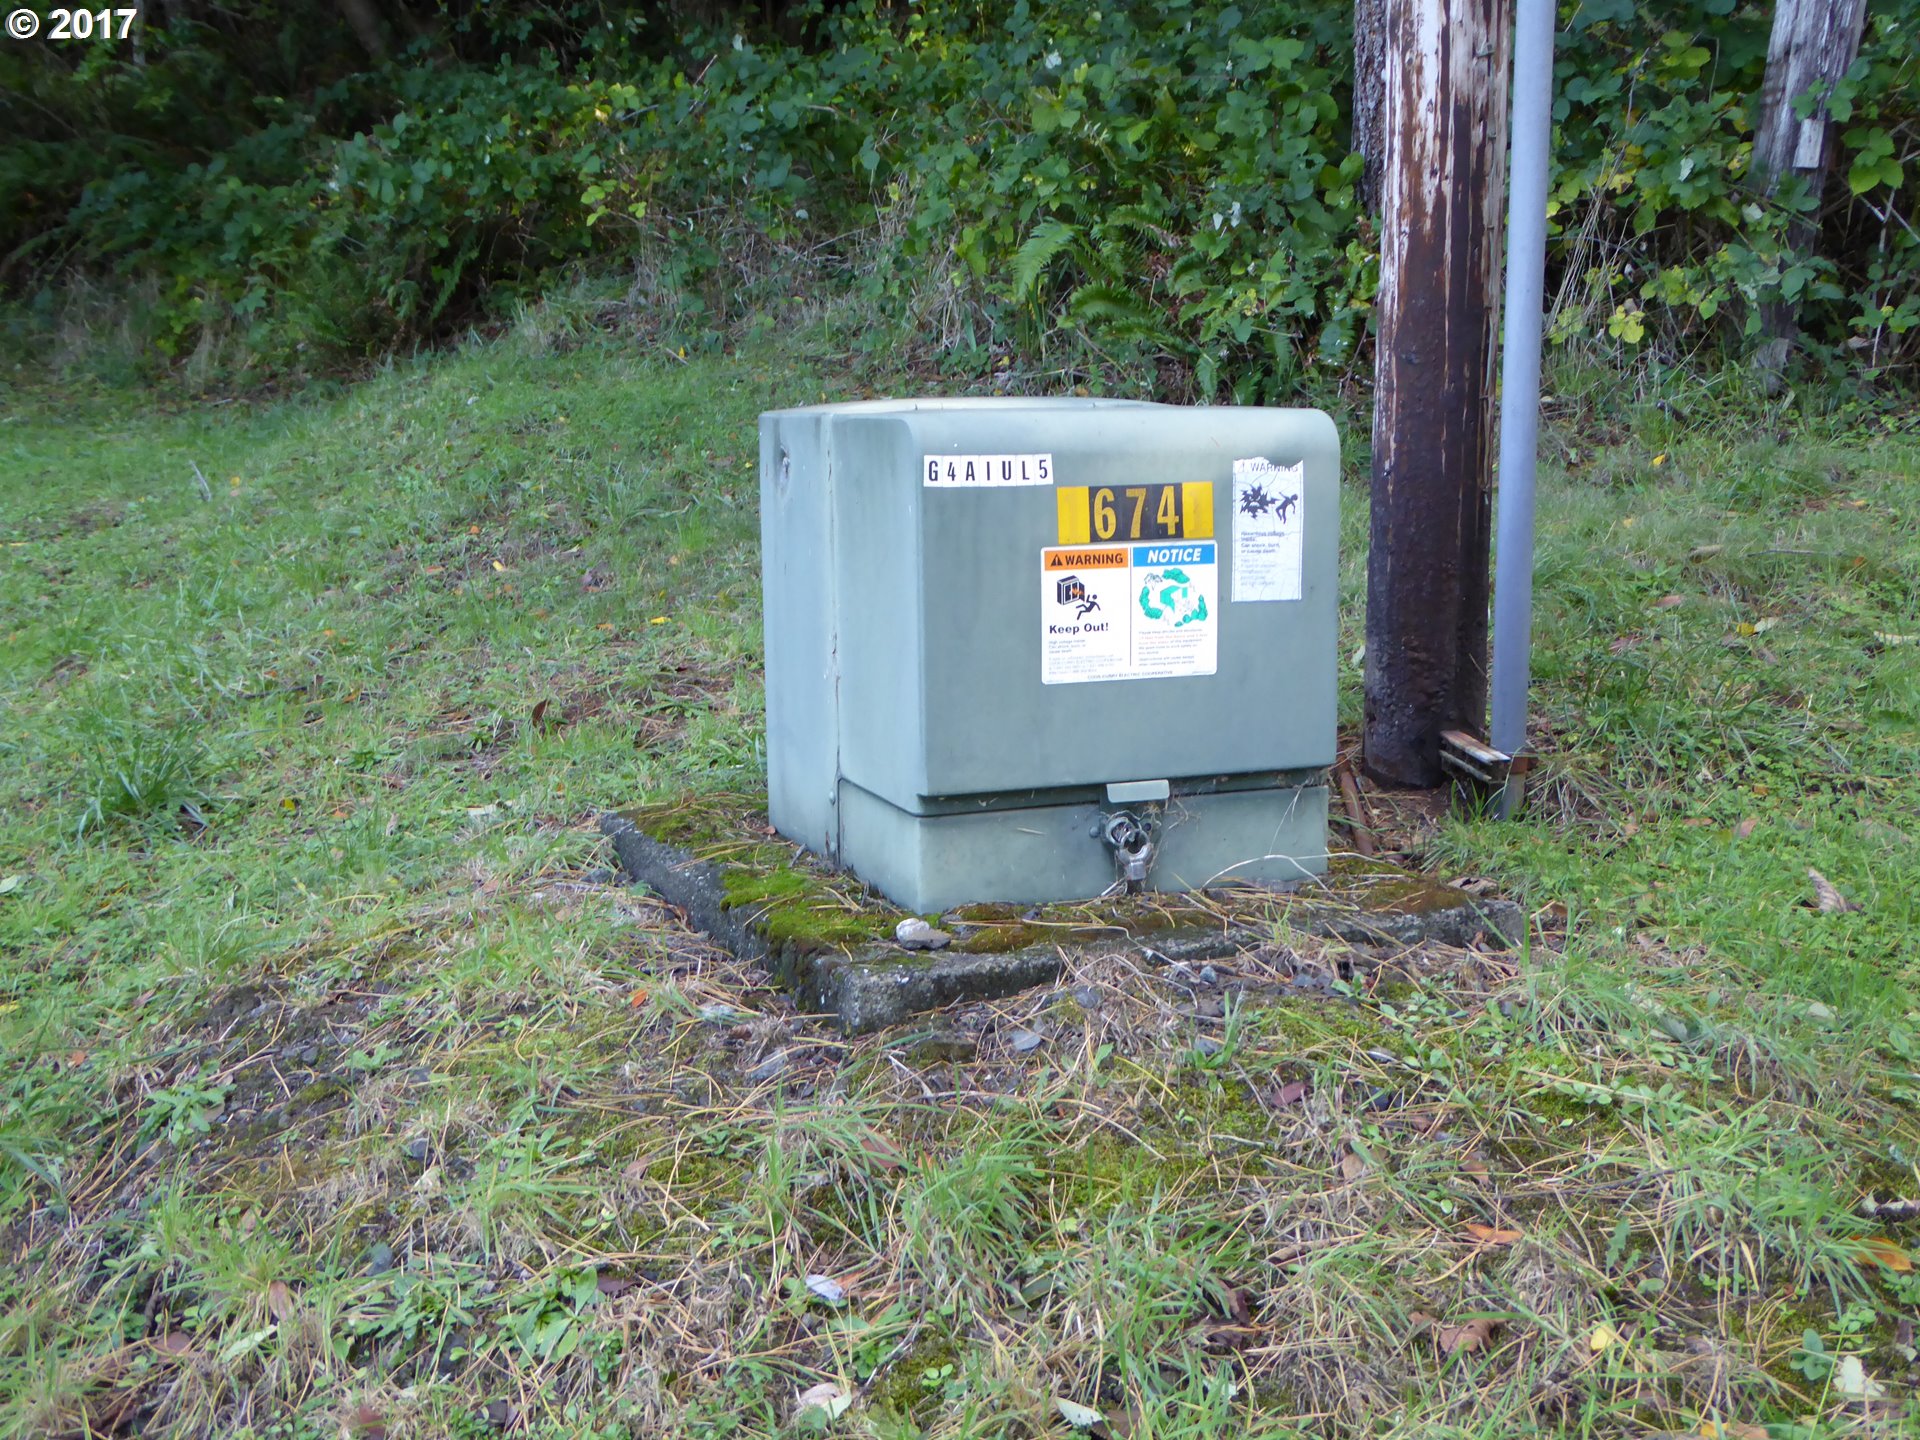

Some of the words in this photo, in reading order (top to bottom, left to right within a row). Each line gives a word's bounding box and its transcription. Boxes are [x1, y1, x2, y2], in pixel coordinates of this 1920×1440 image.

[1093, 485, 1180, 540] 674
[1065, 552, 1124, 567] WARNING
[1147, 547, 1202, 564] NOTICE
[1049, 624, 1080, 636] Keep
[1083, 622, 1109, 633] Out!
